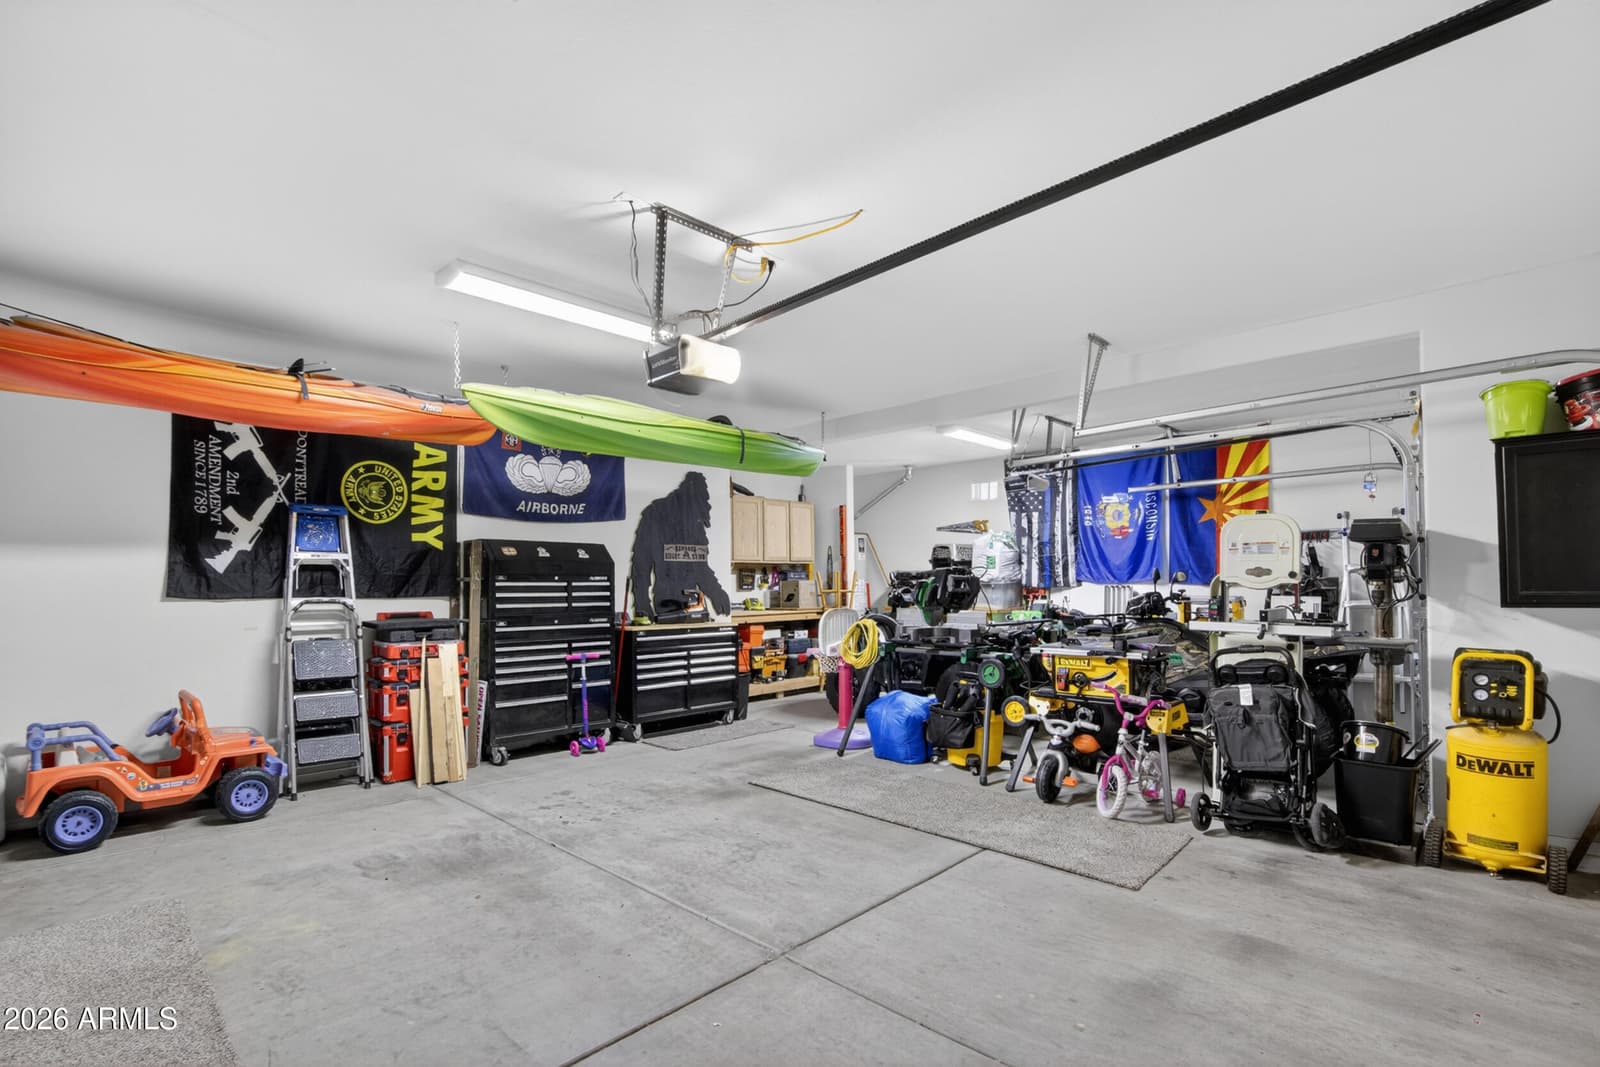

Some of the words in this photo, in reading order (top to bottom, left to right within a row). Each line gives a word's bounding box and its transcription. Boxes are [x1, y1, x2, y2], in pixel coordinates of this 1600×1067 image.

[193, 441, 207, 478] SINCE
[208, 434, 223, 525] AMENDMENT
[226, 471, 240, 495] 2nd
[345, 474, 357, 502] ARMY
[374, 465, 404, 493] UNITED
[193, 479, 208, 514] 1789
[373, 495, 403, 521] STATES
[411, 443, 448, 551] ARMY
[516, 500, 587, 515] AIRBORNE
